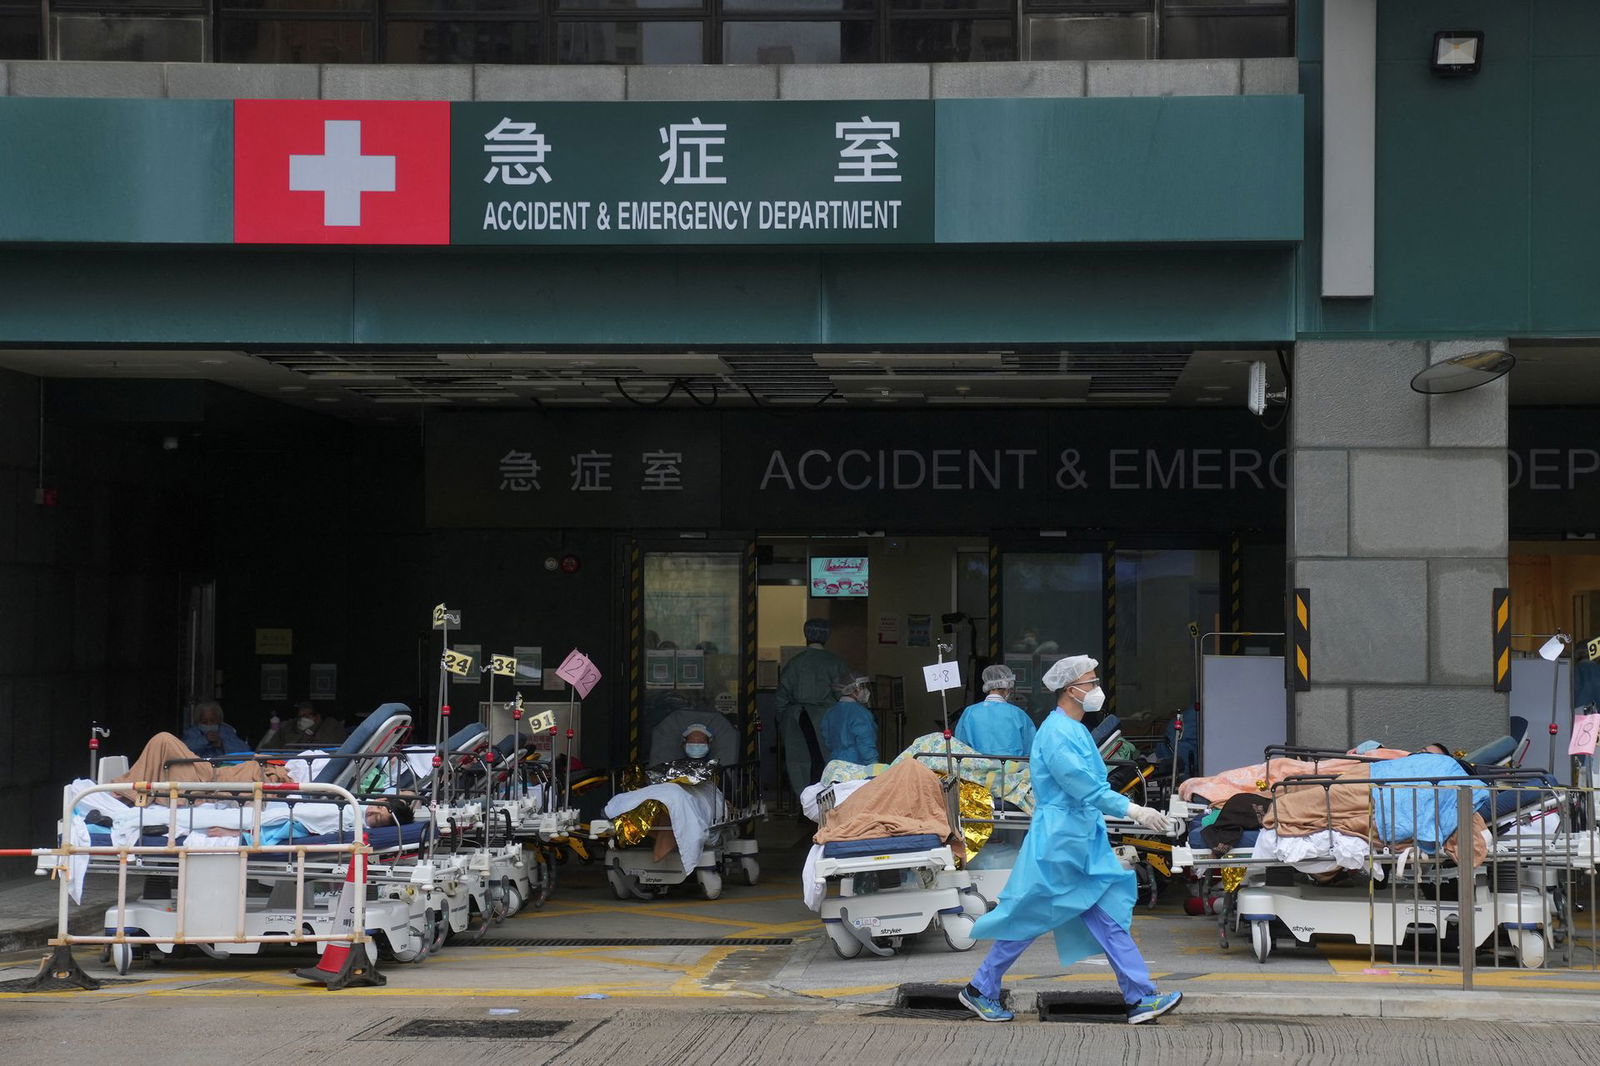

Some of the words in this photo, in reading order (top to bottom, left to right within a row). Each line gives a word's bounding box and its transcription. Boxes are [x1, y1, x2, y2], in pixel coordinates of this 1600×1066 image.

[483, 115, 902, 186] 急症室
[482, 200, 591, 231] ACCIDENT
[596, 201, 611, 231] &
[618, 200, 753, 231] EMERGENCY
[758, 200, 902, 231] DEPARTMENT
[499, 449, 683, 491] 急症室
[760, 449, 1037, 490] ACCIDENT
[1056, 449, 1087, 490] &
[1589, 640, 1600, 657] 9
[445, 654, 469, 674] 24
[494, 658, 516, 674] 34
[563, 653, 585, 678] 12
[531, 713, 554, 731] 91
[880, 927, 902, 935] stryker
[1292, 925, 1316, 933] stryker
